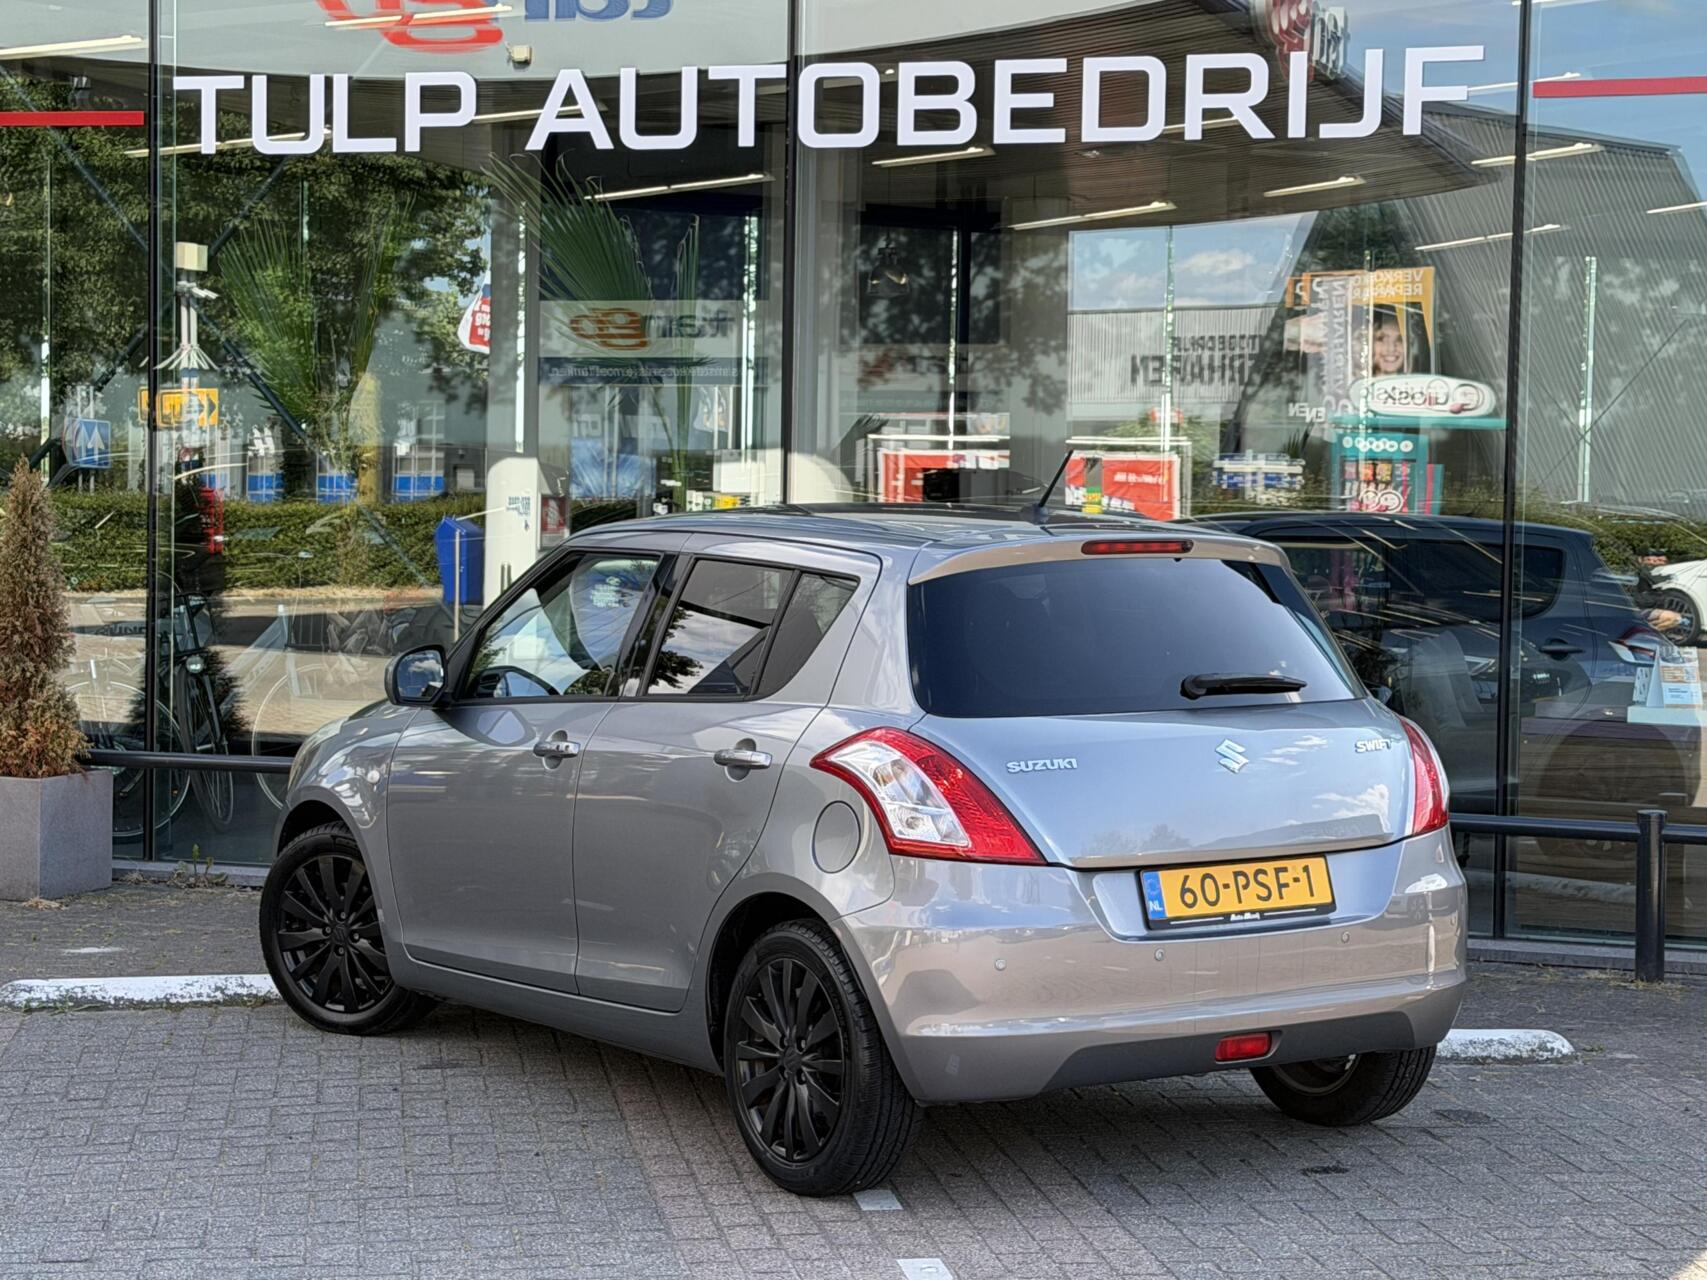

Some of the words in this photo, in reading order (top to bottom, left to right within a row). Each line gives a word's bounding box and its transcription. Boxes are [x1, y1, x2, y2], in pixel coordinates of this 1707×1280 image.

[172, 72, 477, 155] TULP
[525, 45, 1486, 151] AUTOBEDRIJF
[1006, 757, 1078, 773] SUZUKI
[1178, 863, 1316, 909] 60-PSF-1
[1149, 900, 1163, 912] NL
